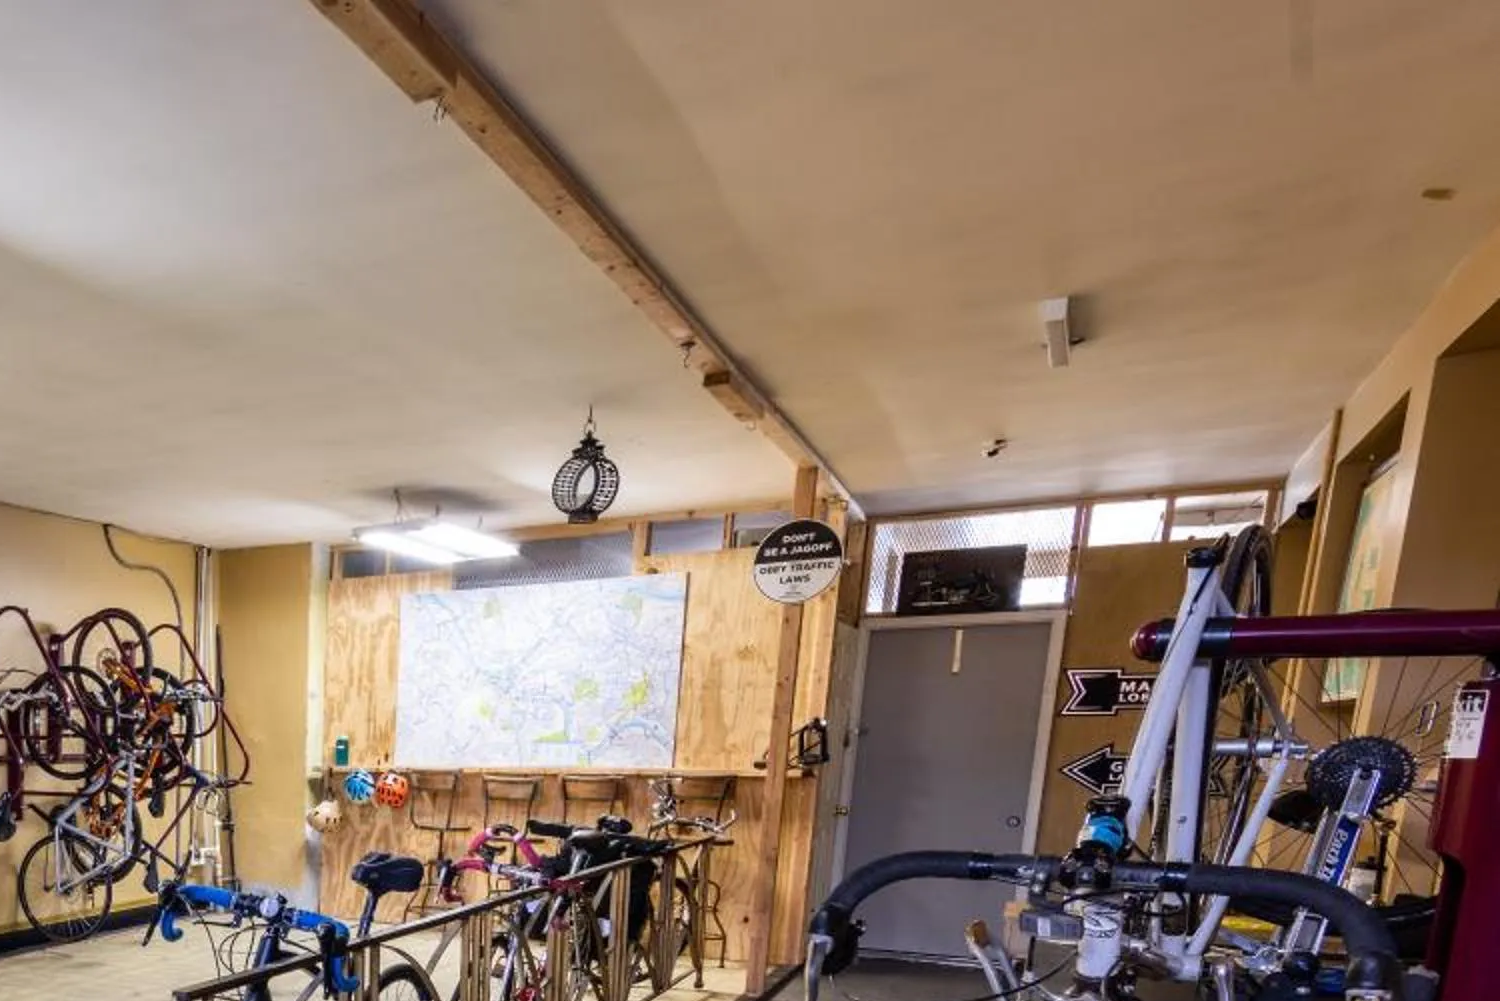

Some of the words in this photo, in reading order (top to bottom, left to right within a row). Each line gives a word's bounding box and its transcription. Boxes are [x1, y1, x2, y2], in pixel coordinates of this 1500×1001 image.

[783, 532, 816, 543] DON'T
[763, 548, 778, 556] BE
[780, 546, 789, 555] A
[790, 542, 833, 554] JAGOFF
[790, 560, 835, 572] TRAFFIC
[779, 574, 811, 585] LAWS
[1119, 681, 1149, 693] MA
